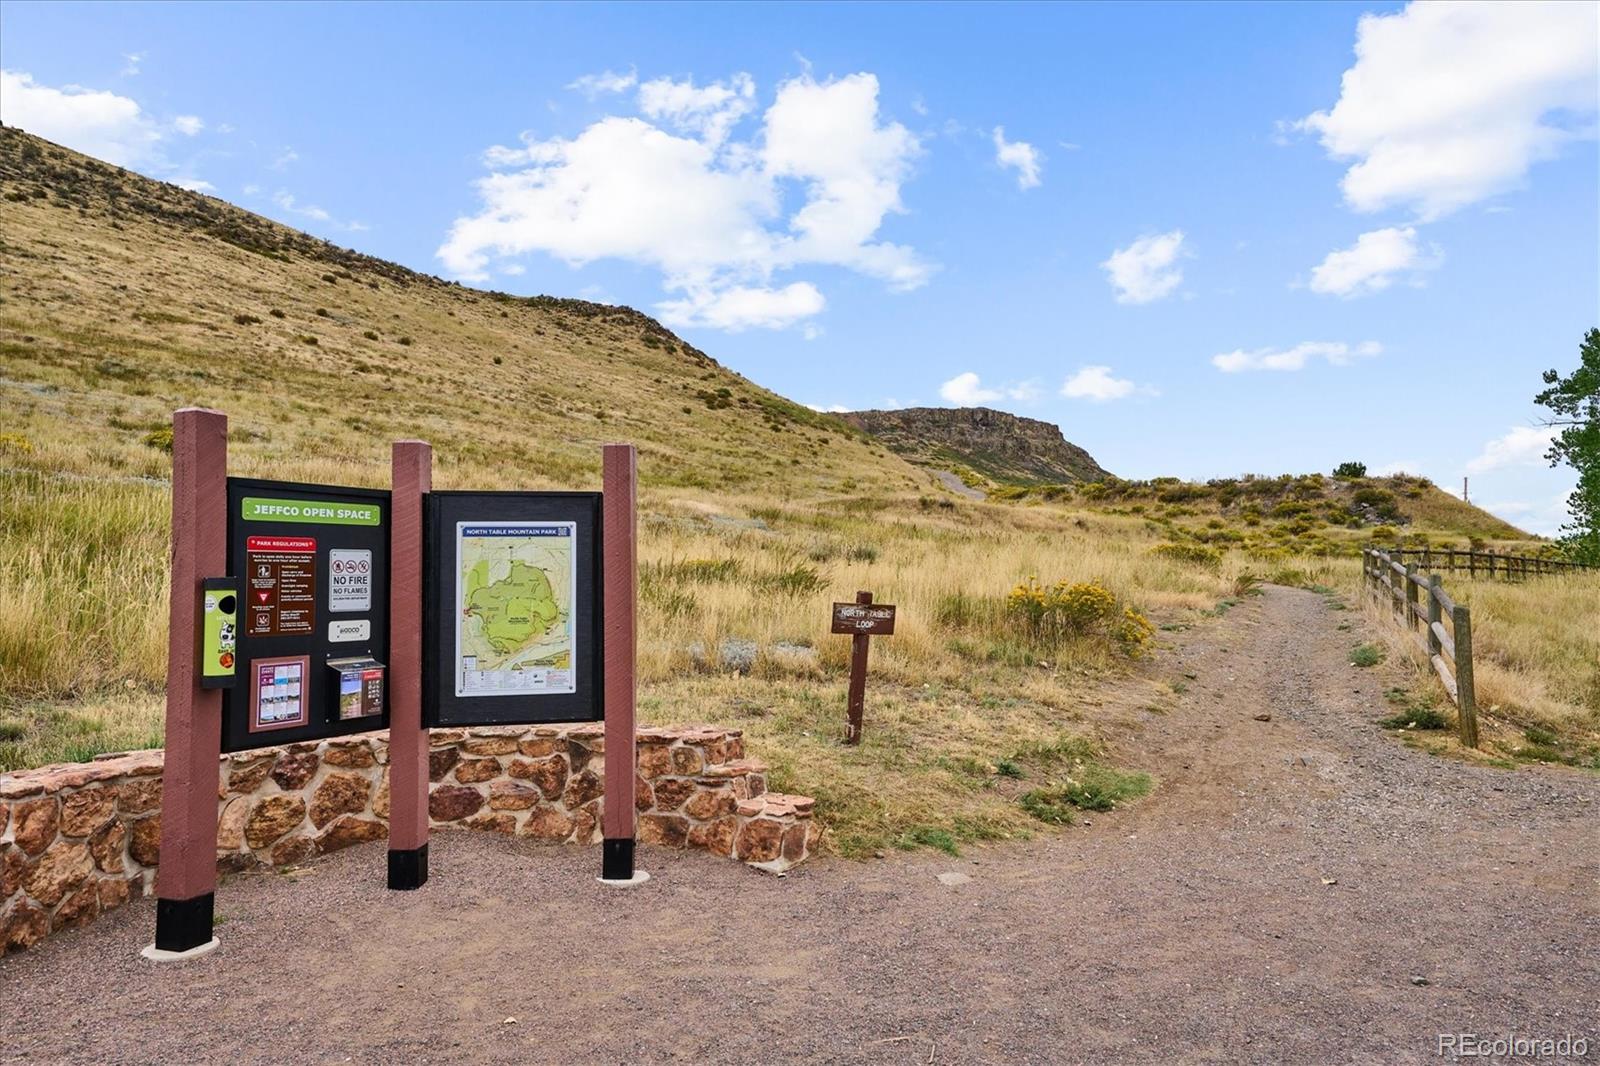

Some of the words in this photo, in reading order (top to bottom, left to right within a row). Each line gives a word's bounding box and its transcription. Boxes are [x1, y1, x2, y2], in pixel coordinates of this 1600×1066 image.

[254, 505, 299, 516] JEFFCO
[303, 507, 334, 518] OPEN
[337, 509, 371, 520] SPACE
[333, 576, 346, 585] NO
[348, 576, 368, 584] FIRE
[841, 608, 864, 617] NORTH
[856, 620, 874, 628] LOOP
